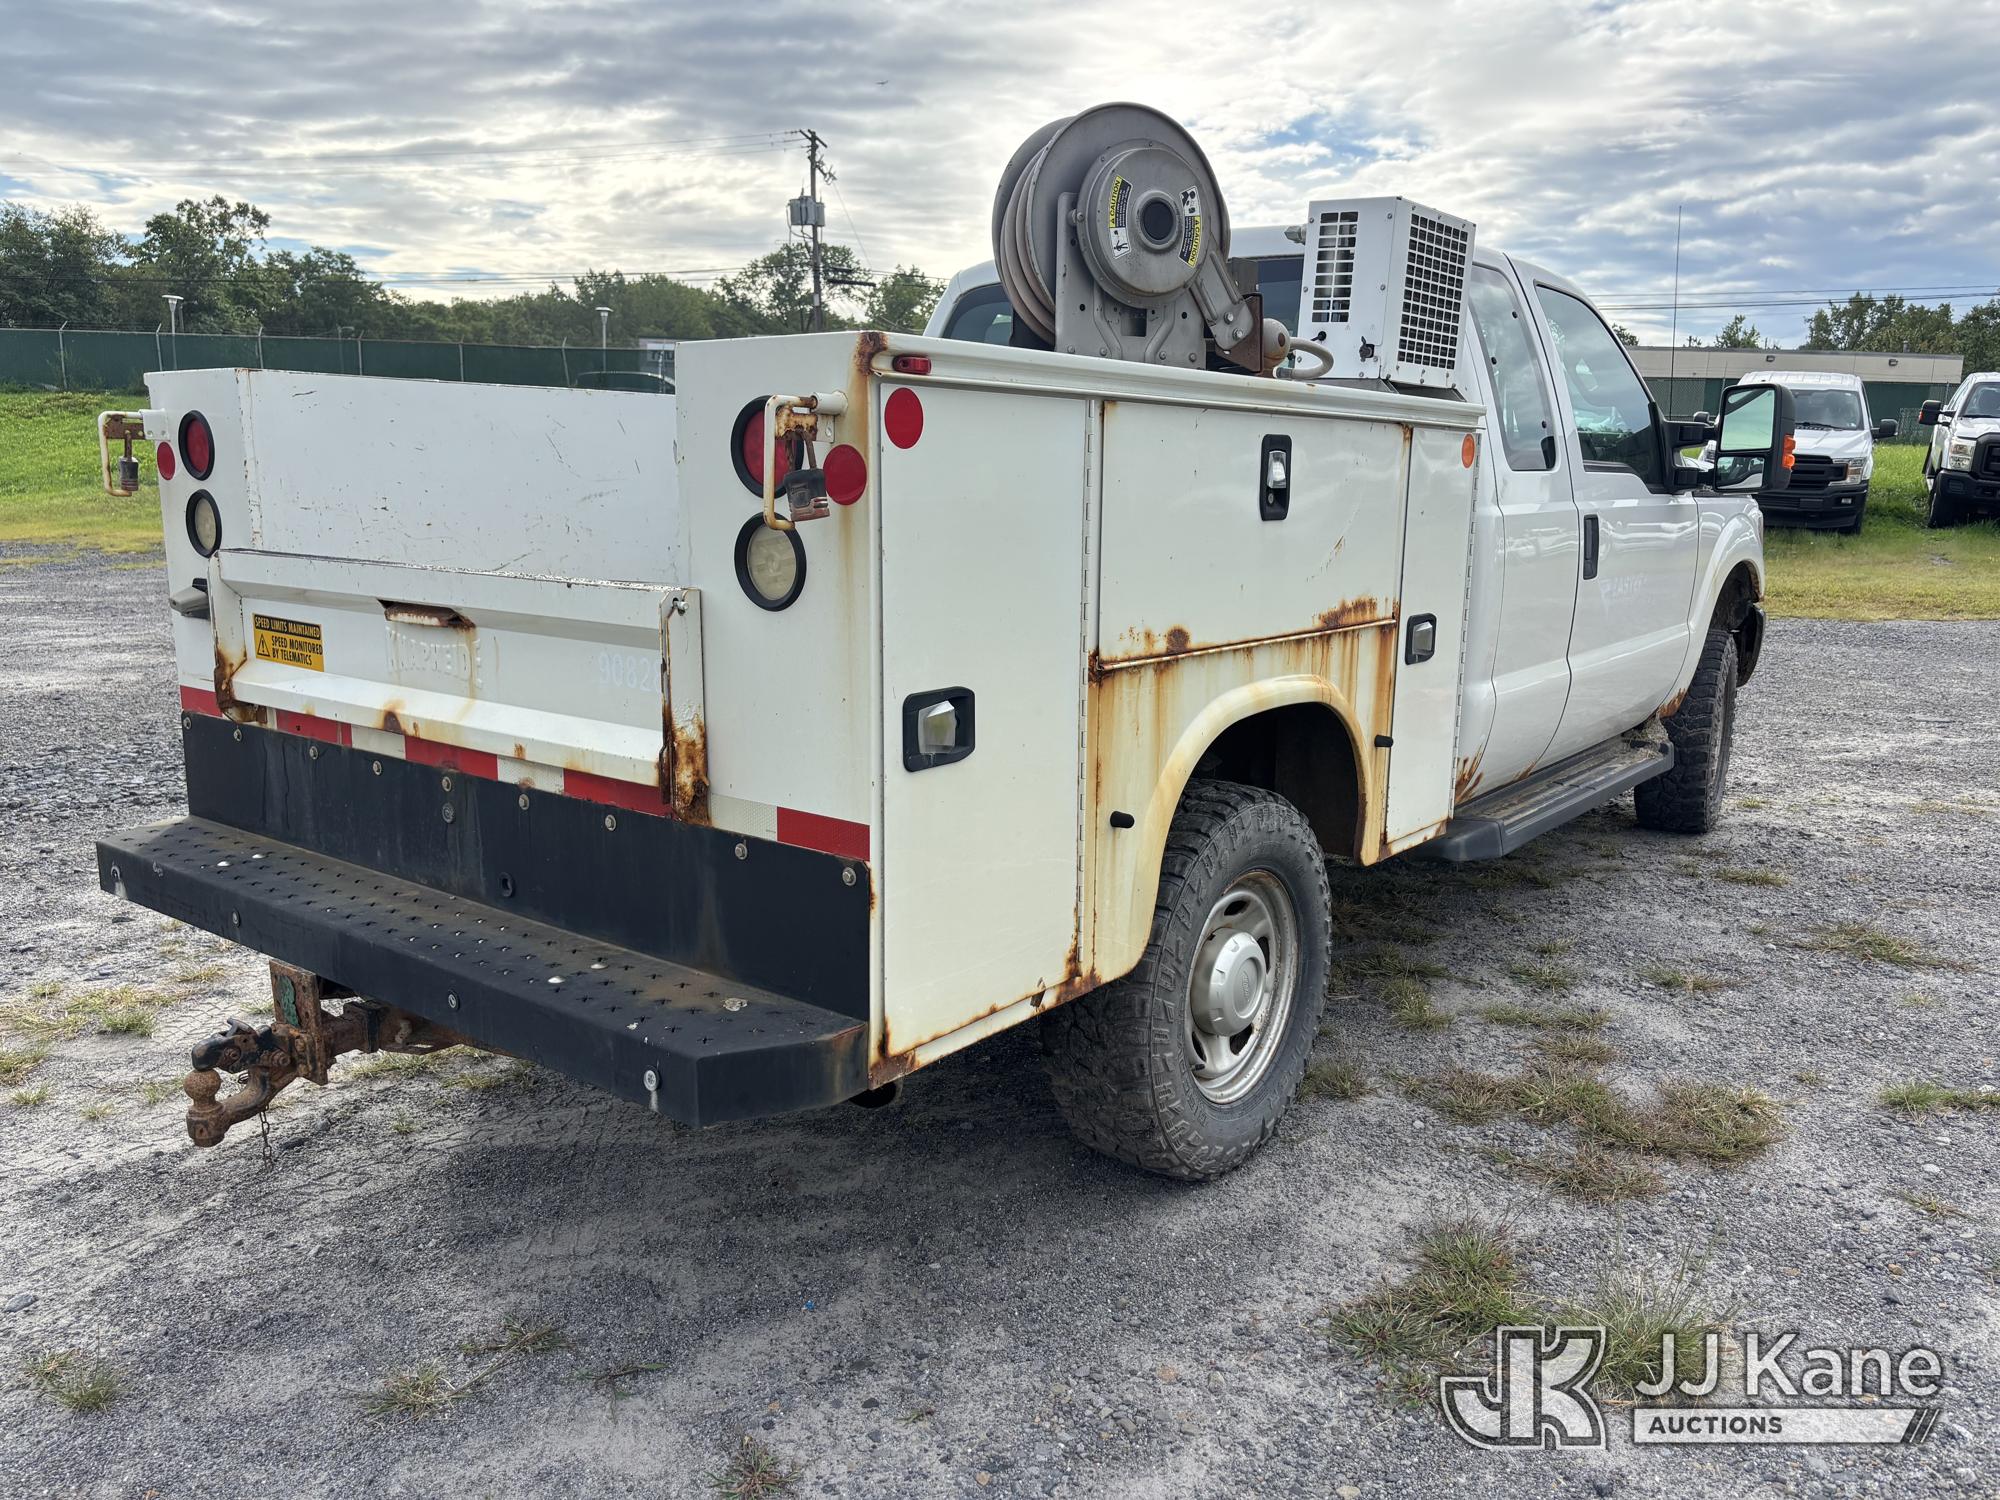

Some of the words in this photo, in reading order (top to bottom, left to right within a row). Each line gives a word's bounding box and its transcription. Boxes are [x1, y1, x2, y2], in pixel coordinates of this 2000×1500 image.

[1109, 180, 1120, 216] CAUTION
[1190, 227, 1200, 261] CAUTION
[255, 617, 270, 628] SPEED
[270, 619, 288, 632] LIMITS
[288, 623, 320, 637] MAINTAINED
[271, 635, 288, 648] SPEED
[289, 638, 323, 655] MONITORED
[272, 647, 279, 659] BY
[280, 649, 312, 666] TELEMATICS
